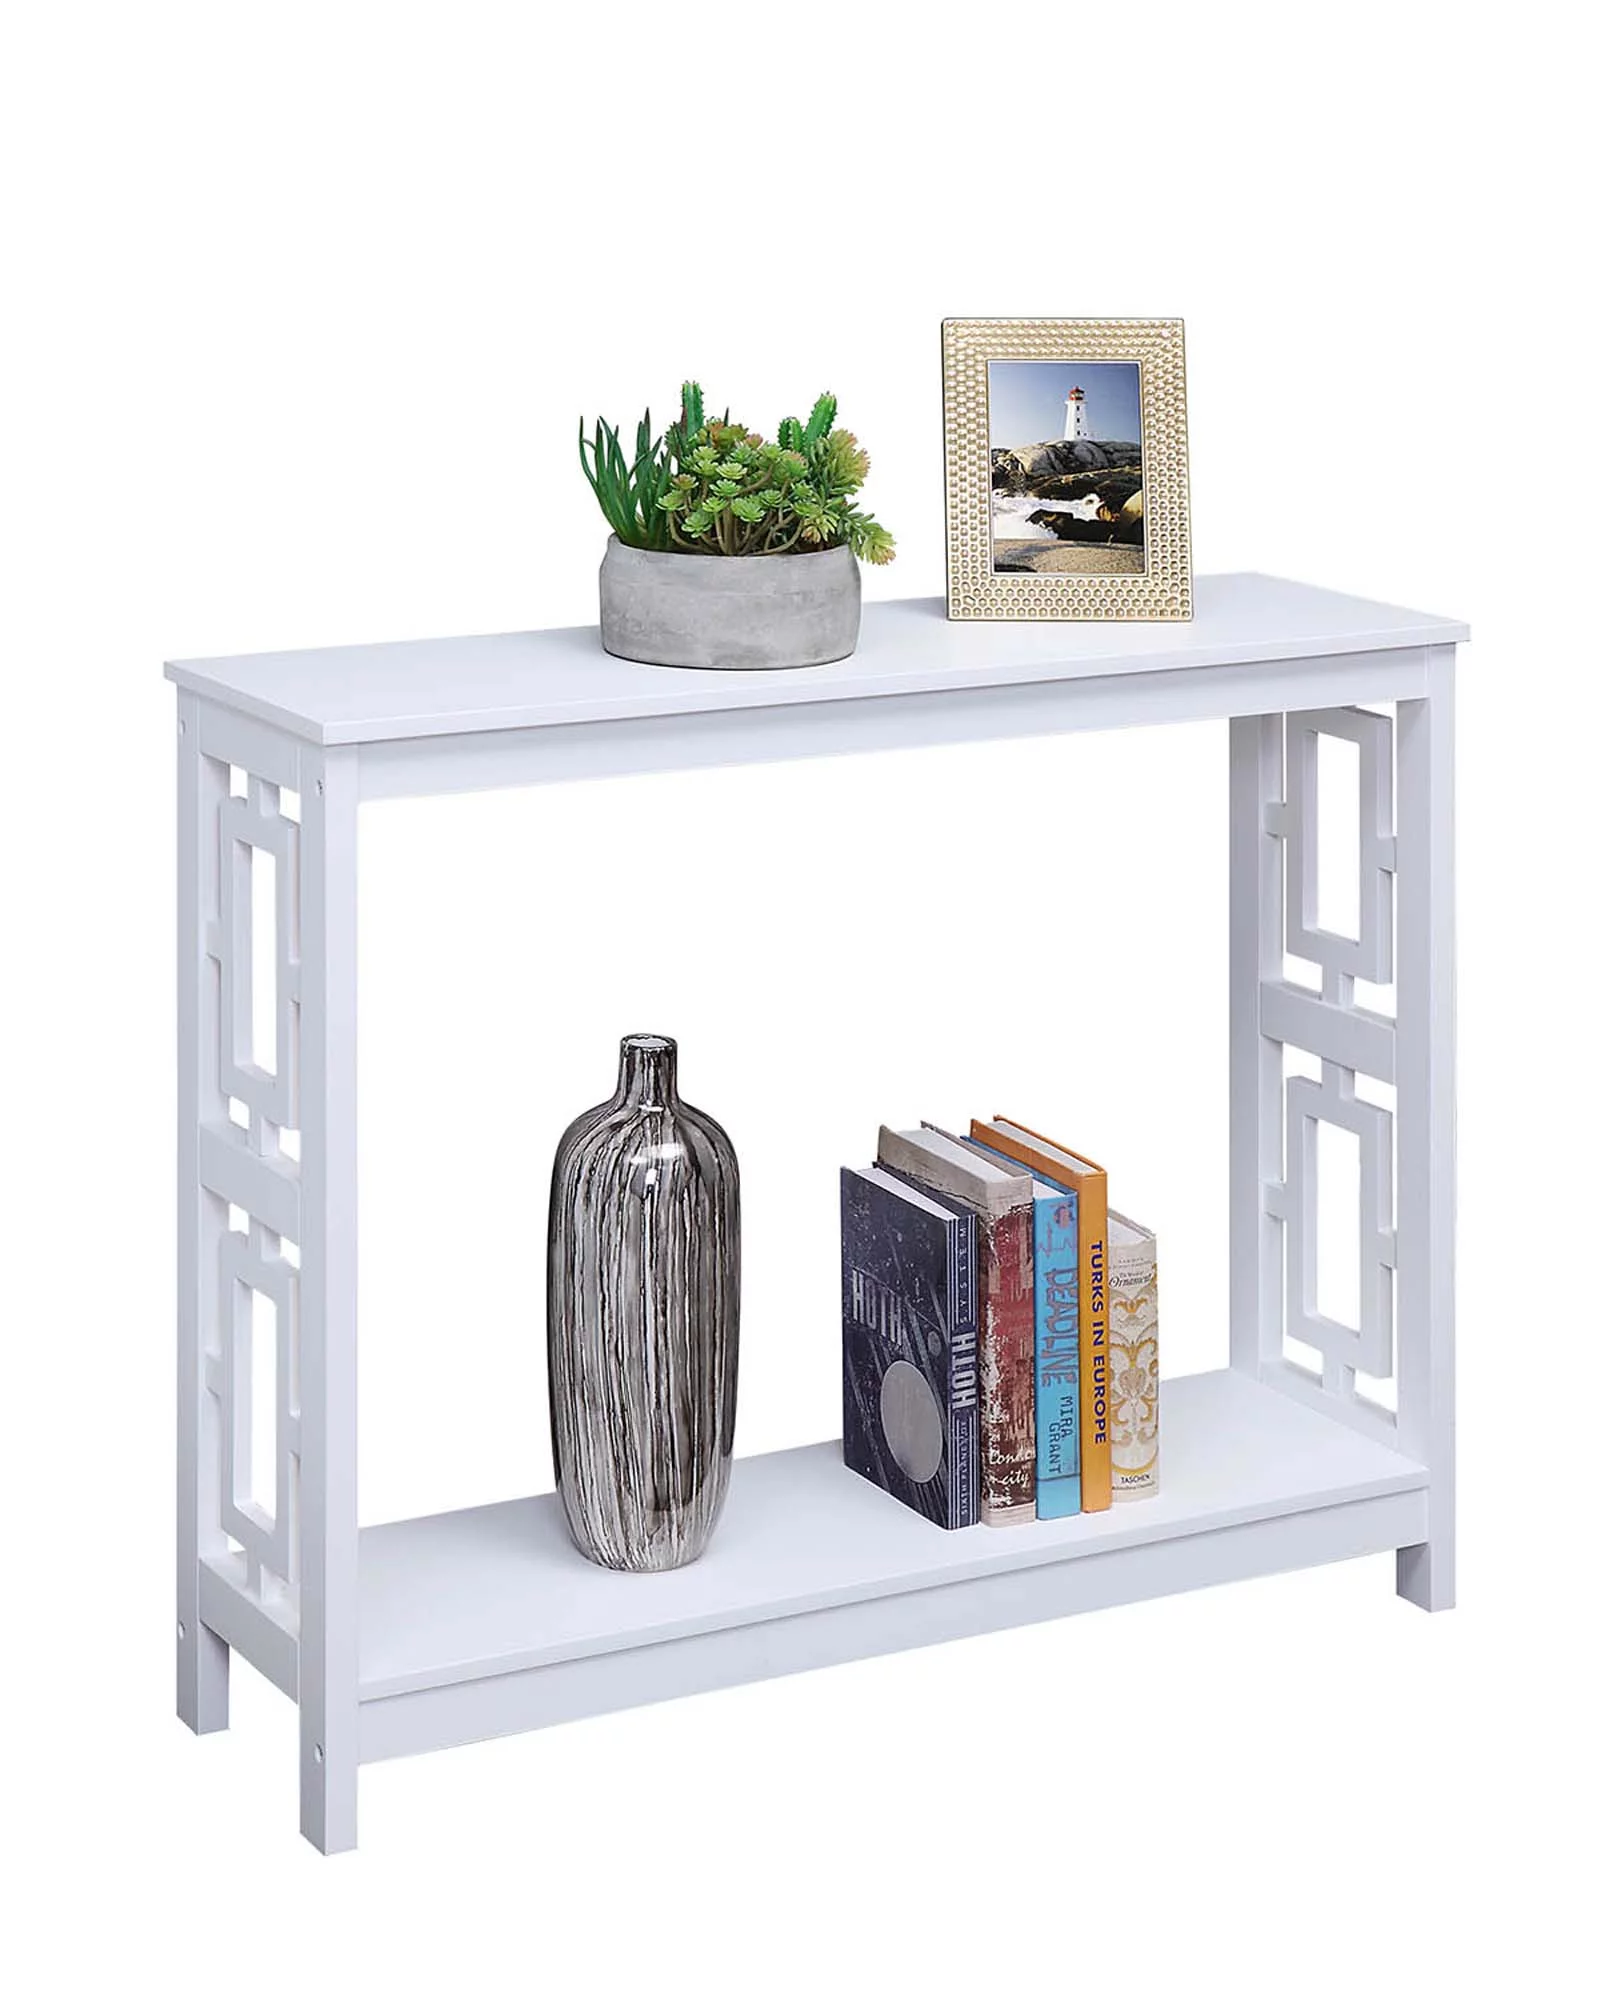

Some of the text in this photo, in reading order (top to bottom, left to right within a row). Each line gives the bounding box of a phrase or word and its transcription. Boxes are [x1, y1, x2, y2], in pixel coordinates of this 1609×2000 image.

[852, 1268, 902, 1346] HOTH
[959, 1227, 967, 1324] SYSTEM
[1041, 1267, 1079, 1388] DEADLINE
[1091, 1240, 1106, 1444] TURKS IN EUROPE
[951, 1331, 976, 1410] HOTH
[1048, 1422, 1061, 1473] GRANT
[1060, 1395, 1073, 1438] MIRA
[1002, 1470, 1029, 1488] city
[1120, 1474, 1150, 1484] TASCHEN
